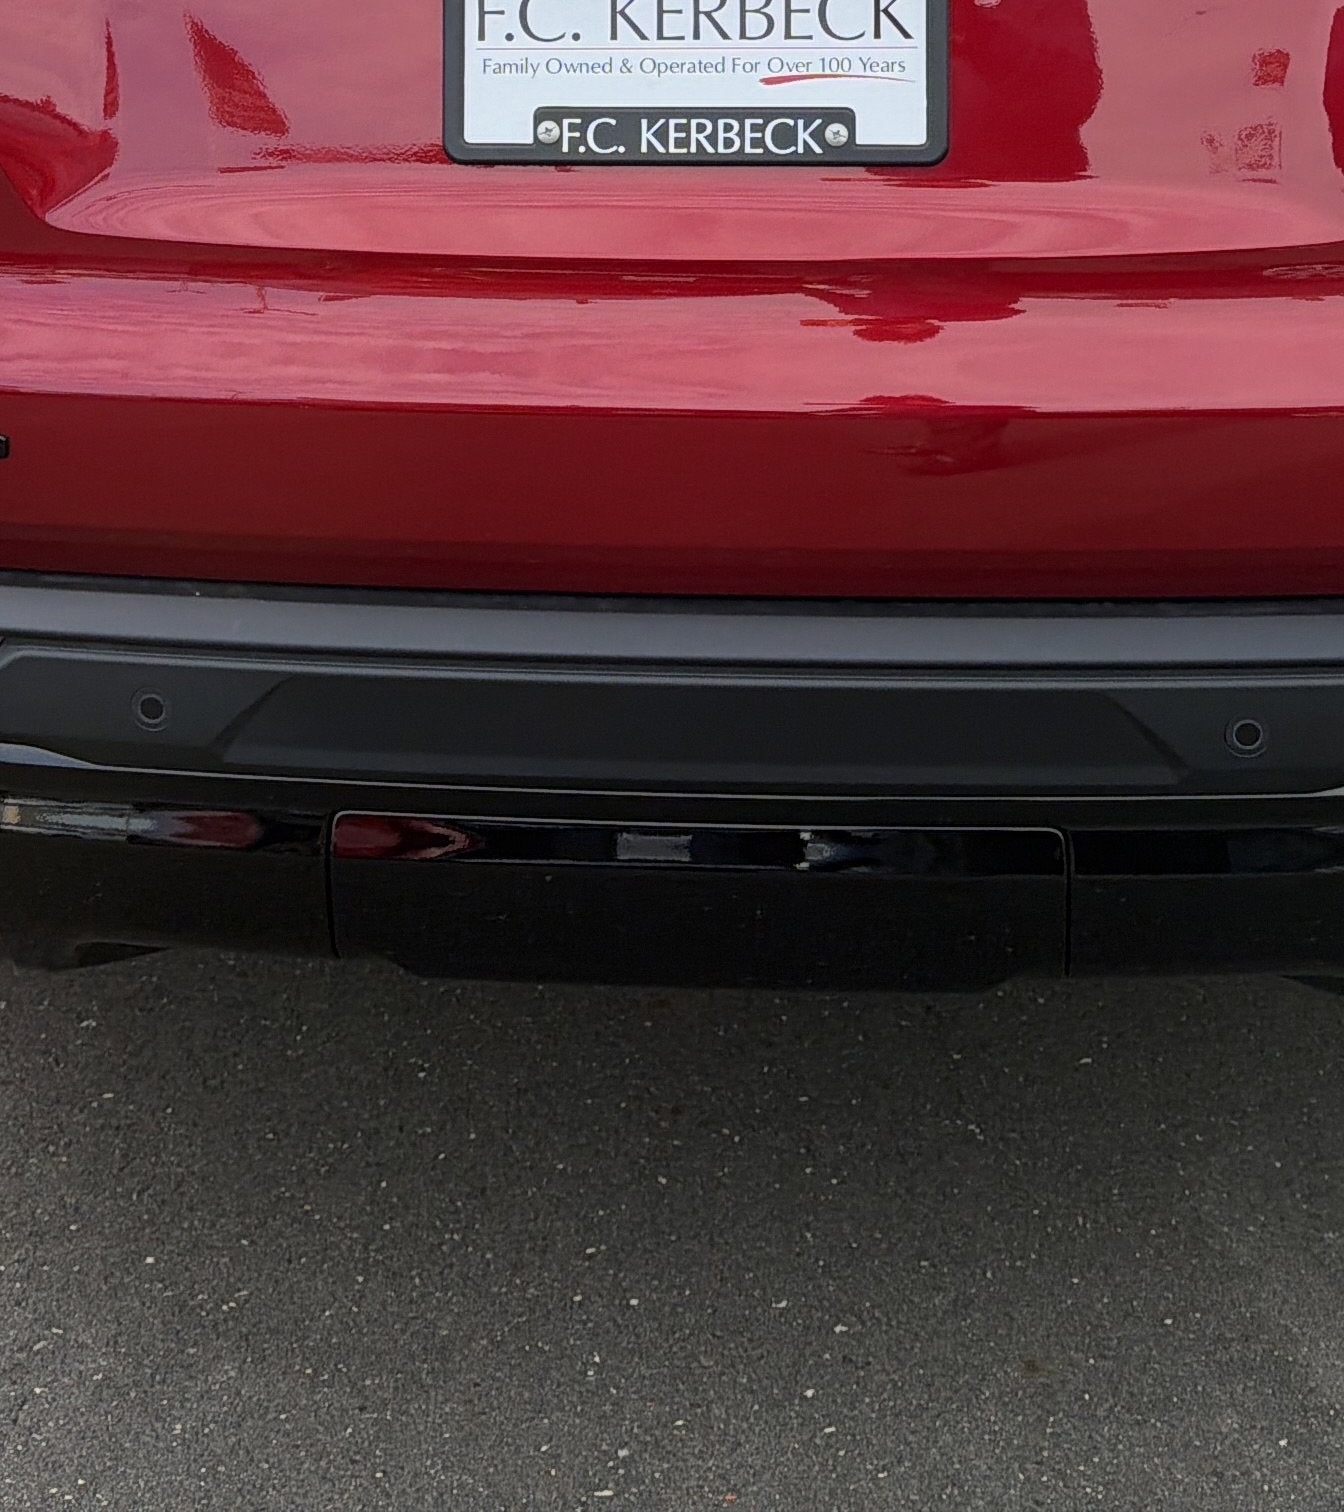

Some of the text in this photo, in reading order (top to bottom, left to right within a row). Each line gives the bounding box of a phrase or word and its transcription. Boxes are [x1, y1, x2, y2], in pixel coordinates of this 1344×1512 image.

[482, 55, 906, 79] Family Owned & Operated For Over 100 Years
[561, 117, 824, 154] F.C. KERBECK
